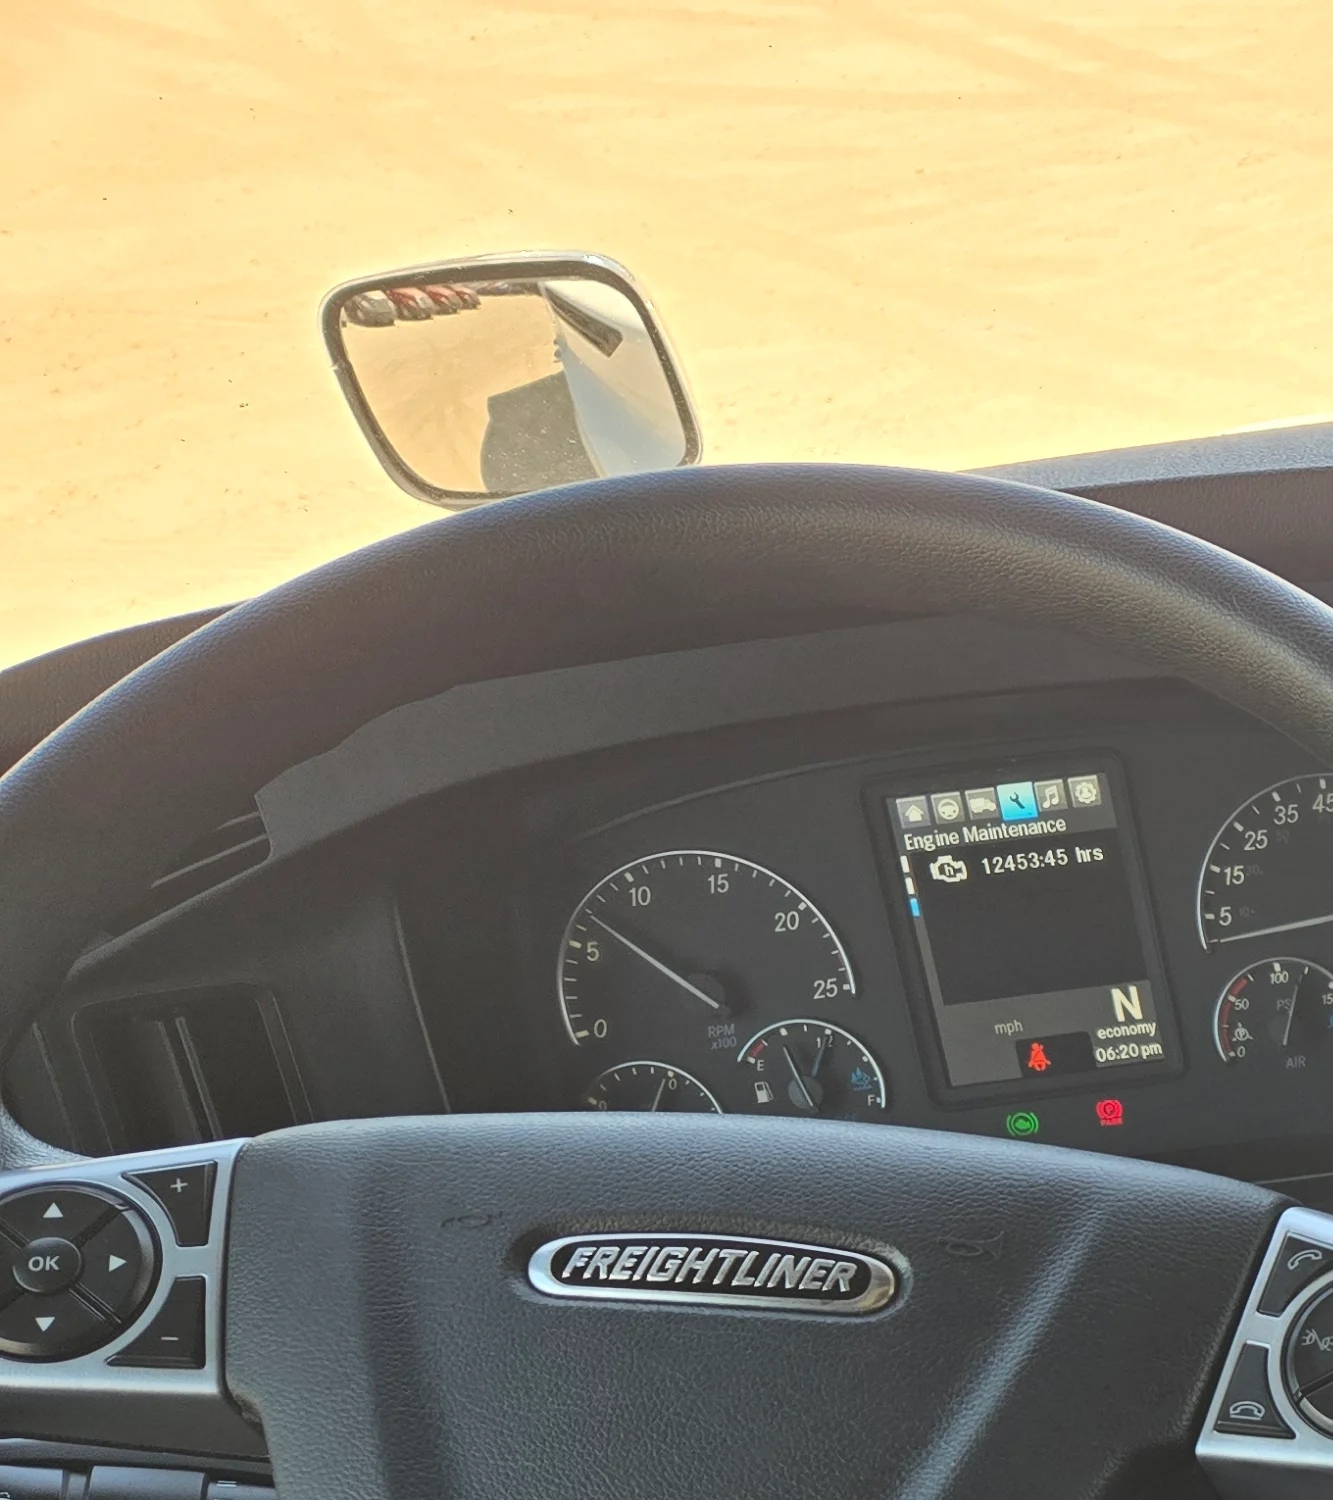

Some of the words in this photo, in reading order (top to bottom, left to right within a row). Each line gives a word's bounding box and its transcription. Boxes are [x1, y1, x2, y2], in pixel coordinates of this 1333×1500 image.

[1273, 805, 1298, 825] 35
[904, 832, 959, 851] Engine
[962, 818, 1066, 843] Maintenance
[1244, 830, 1268, 850] 25
[981, 848, 1068, 875] 12453:45
[1076, 847, 1103, 863] hrs
[708, 875, 729, 893] 15
[1223, 866, 1244, 885] 15
[629, 888, 651, 906] 10
[774, 912, 799, 931] 20
[1219, 908, 1232, 926] 5
[586, 942, 599, 961] 5
[1270, 971, 1288, 984] 100
[813, 979, 838, 999] 25
[1111, 986, 1143, 1022] N
[1234, 998, 1249, 1010] 50
[594, 1020, 607, 1038] 0
[708, 1024, 735, 1037] RPM
[994, 1020, 1023, 1035] mph
[1097, 1022, 1156, 1039] economy
[1096, 1043, 1139, 1062] 06:20
[1141, 1043, 1162, 1059] pm
[1237, 1046, 1245, 1058] 0
[757, 1059, 764, 1071] E
[1286, 1056, 1306, 1069] AIR
[867, 1095, 875, 1105] F
[28, 1255, 59, 1272] OK
[561, 1246, 857, 1292] FREIGHTLINER
